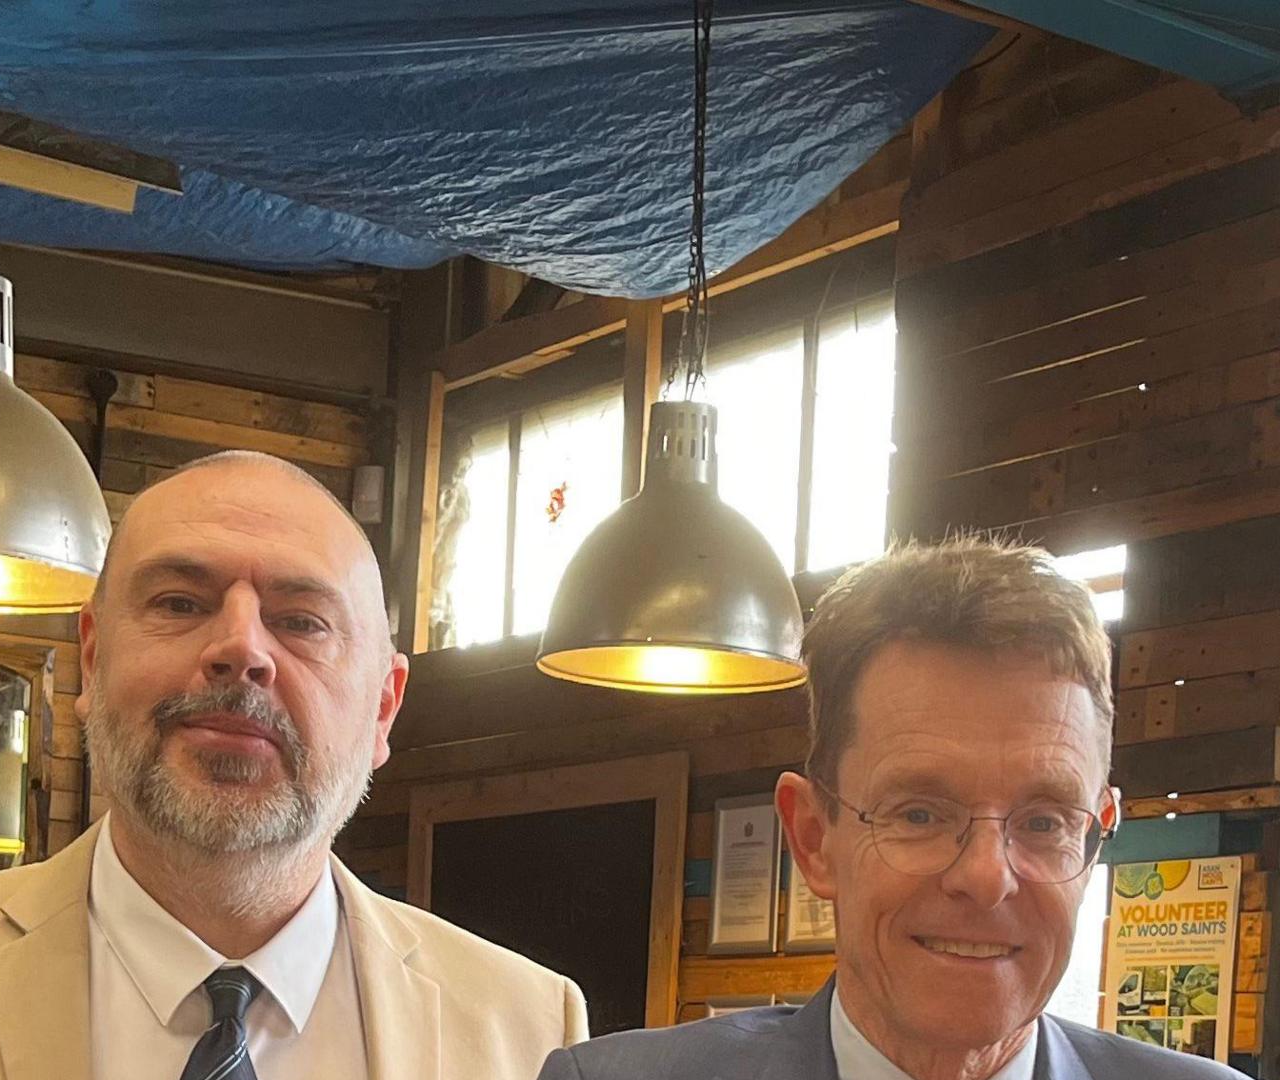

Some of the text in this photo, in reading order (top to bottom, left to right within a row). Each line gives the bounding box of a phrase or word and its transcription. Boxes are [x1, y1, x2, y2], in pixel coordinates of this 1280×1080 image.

[1120, 901, 1227, 922] VOLUNTEER
[1117, 921, 1227, 937] AT WOOD SAINTS
